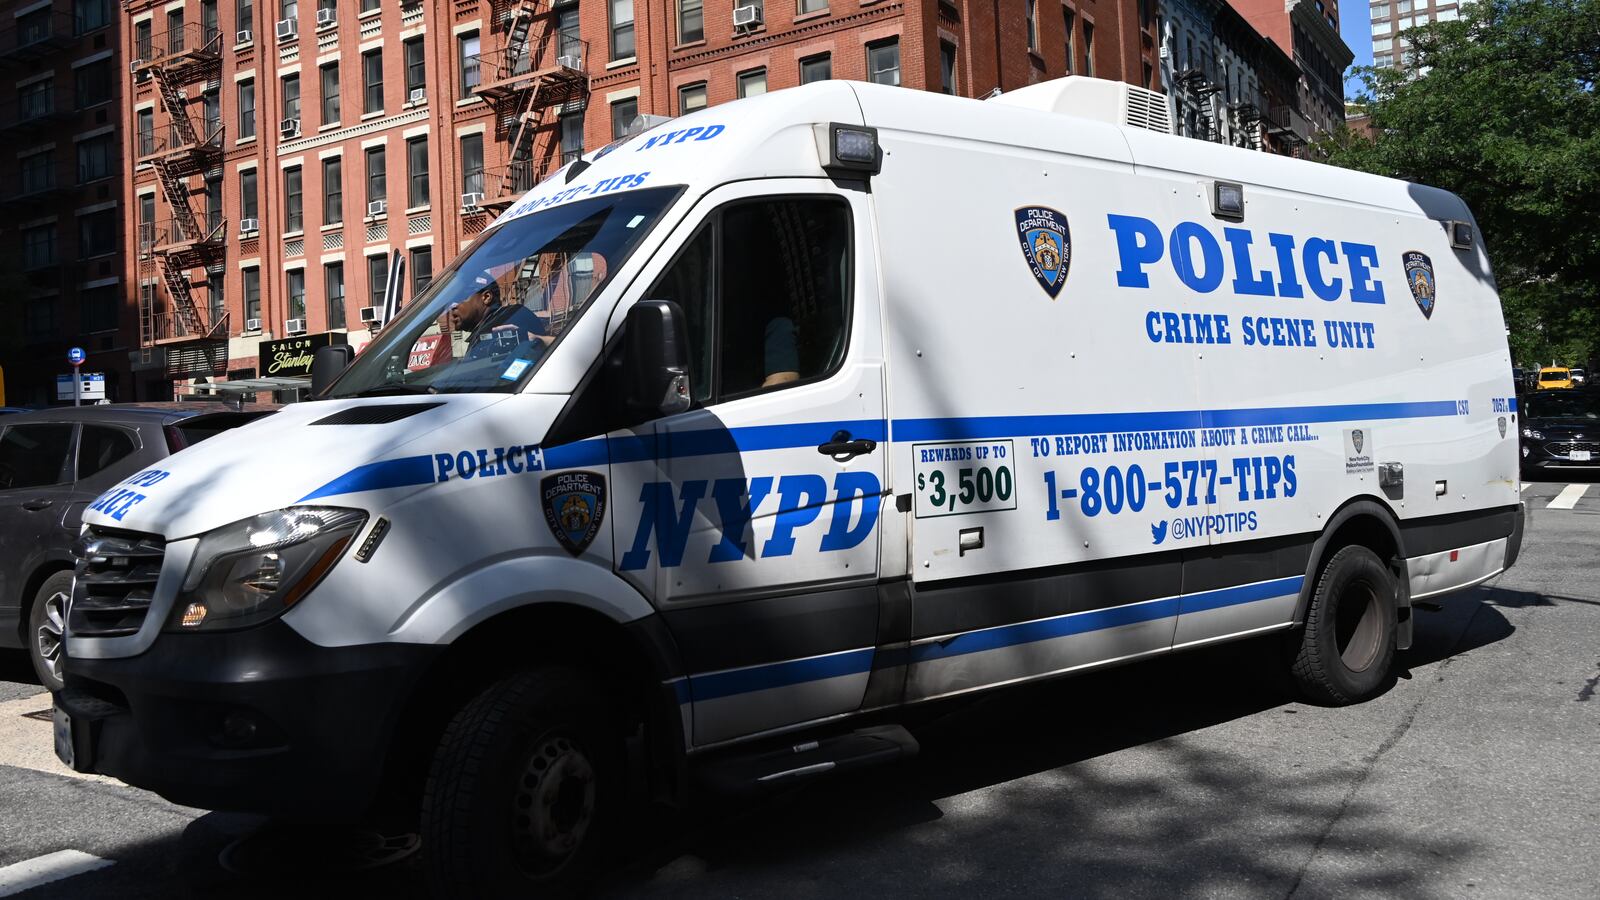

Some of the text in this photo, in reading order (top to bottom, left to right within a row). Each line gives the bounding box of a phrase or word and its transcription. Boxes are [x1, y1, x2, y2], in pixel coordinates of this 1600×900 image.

[635, 124, 726, 152] NYPD
[1020, 219, 1066, 235] DEPARTMENT
[1028, 209, 1055, 220] POLICE
[1022, 242, 1043, 279] CITY OF
[1107, 213, 1386, 304] POLICE
[1057, 264, 1068, 284] NEW
[1146, 311, 1375, 349] CRIME SCENE UNIT
[271, 340, 311, 352] SALON
[268, 350, 314, 374] Stanley
[1458, 400, 1470, 415] CSU
[921, 446, 1006, 462] REWARDS UP TO
[1031, 424, 1319, 457] TO REPORT INFORMATION ABOUT A CRIME CALL...
[435, 445, 543, 482] POLICE
[545, 482, 602, 500] DEPARTMENT
[557, 474, 589, 485] POLICE
[918, 465, 1012, 512] $3,500
[1044, 455, 1297, 520] 1-800-577-TIPS
[619, 471, 881, 571] NYPD
[1171, 510, 1258, 540] @NYPDTIPS
